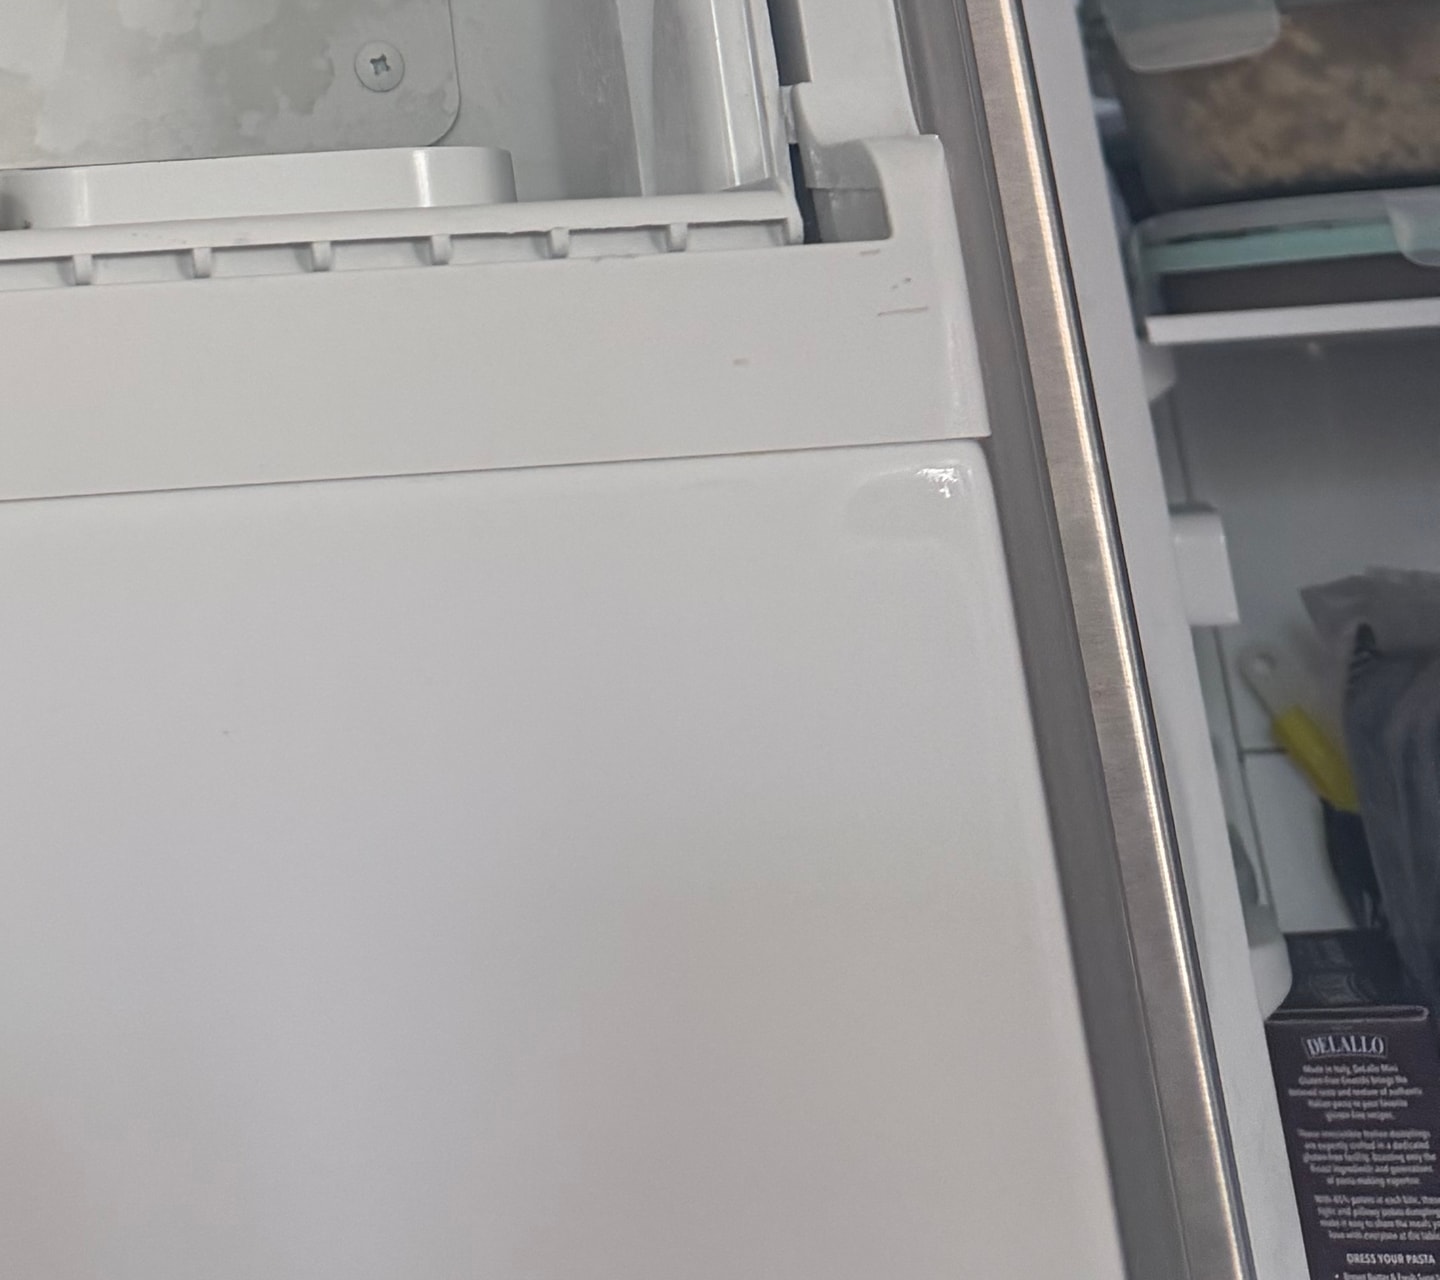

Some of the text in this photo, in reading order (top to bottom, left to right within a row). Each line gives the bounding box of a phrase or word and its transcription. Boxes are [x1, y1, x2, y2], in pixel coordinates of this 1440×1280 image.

[1306, 1035, 1384, 1056] DELALLO
[1346, 1253, 1436, 1265] DRESS YOUR PASTA
